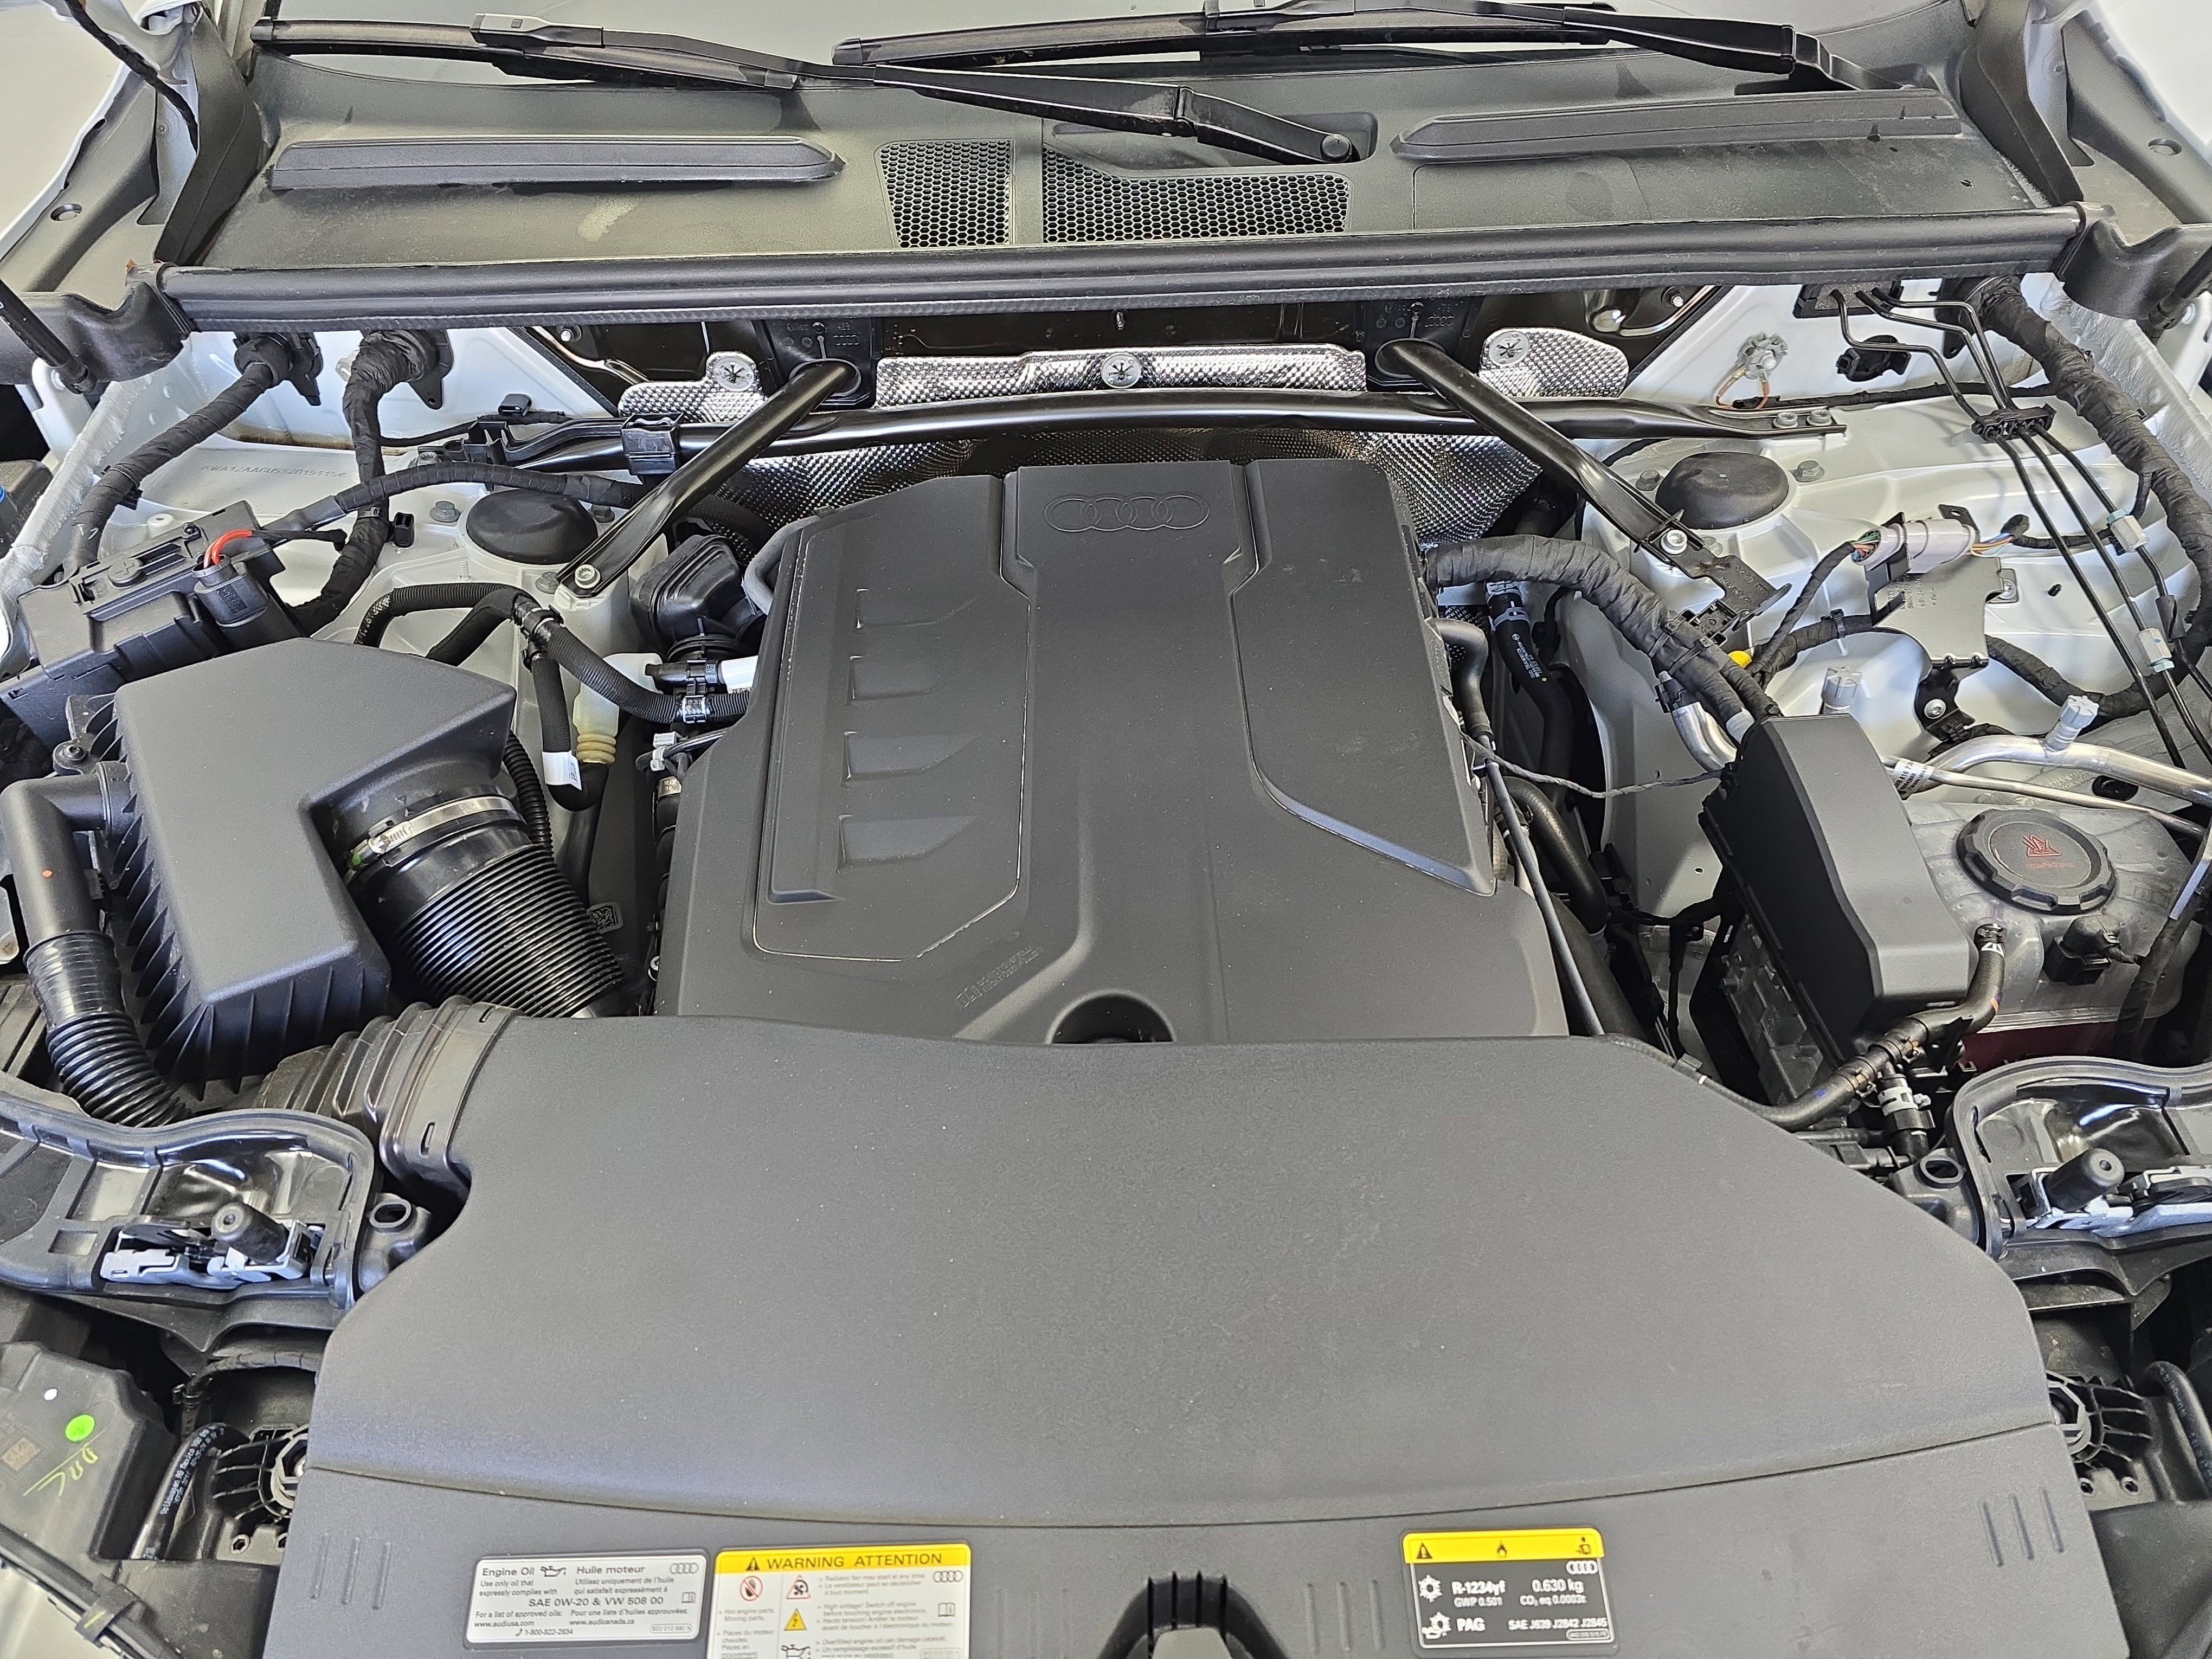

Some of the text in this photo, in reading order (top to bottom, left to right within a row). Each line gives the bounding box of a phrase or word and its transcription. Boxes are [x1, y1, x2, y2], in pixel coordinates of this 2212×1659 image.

[767, 1553, 942, 1569] WARNING ATTENTION
[482, 1567, 535, 1577] Engine Oil
[576, 1566, 646, 1574] Huile moteur
[495, 1580, 510, 1588] only
[601, 1577, 642, 1586] uniquement
[1451, 1578, 1584, 1596] R-1234yf 0.630 kg
[479, 1589, 510, 1597] expressly
[512, 1589, 542, 1597] complies
[528, 1596, 664, 1607] SAE 0W-20 & VW 508 00
[1539, 1597, 1553, 1606] eq
[515, 1609, 547, 1619] approved
[1456, 1617, 1486, 1632] PAG
[1508, 1619, 1529, 1630] SAE
